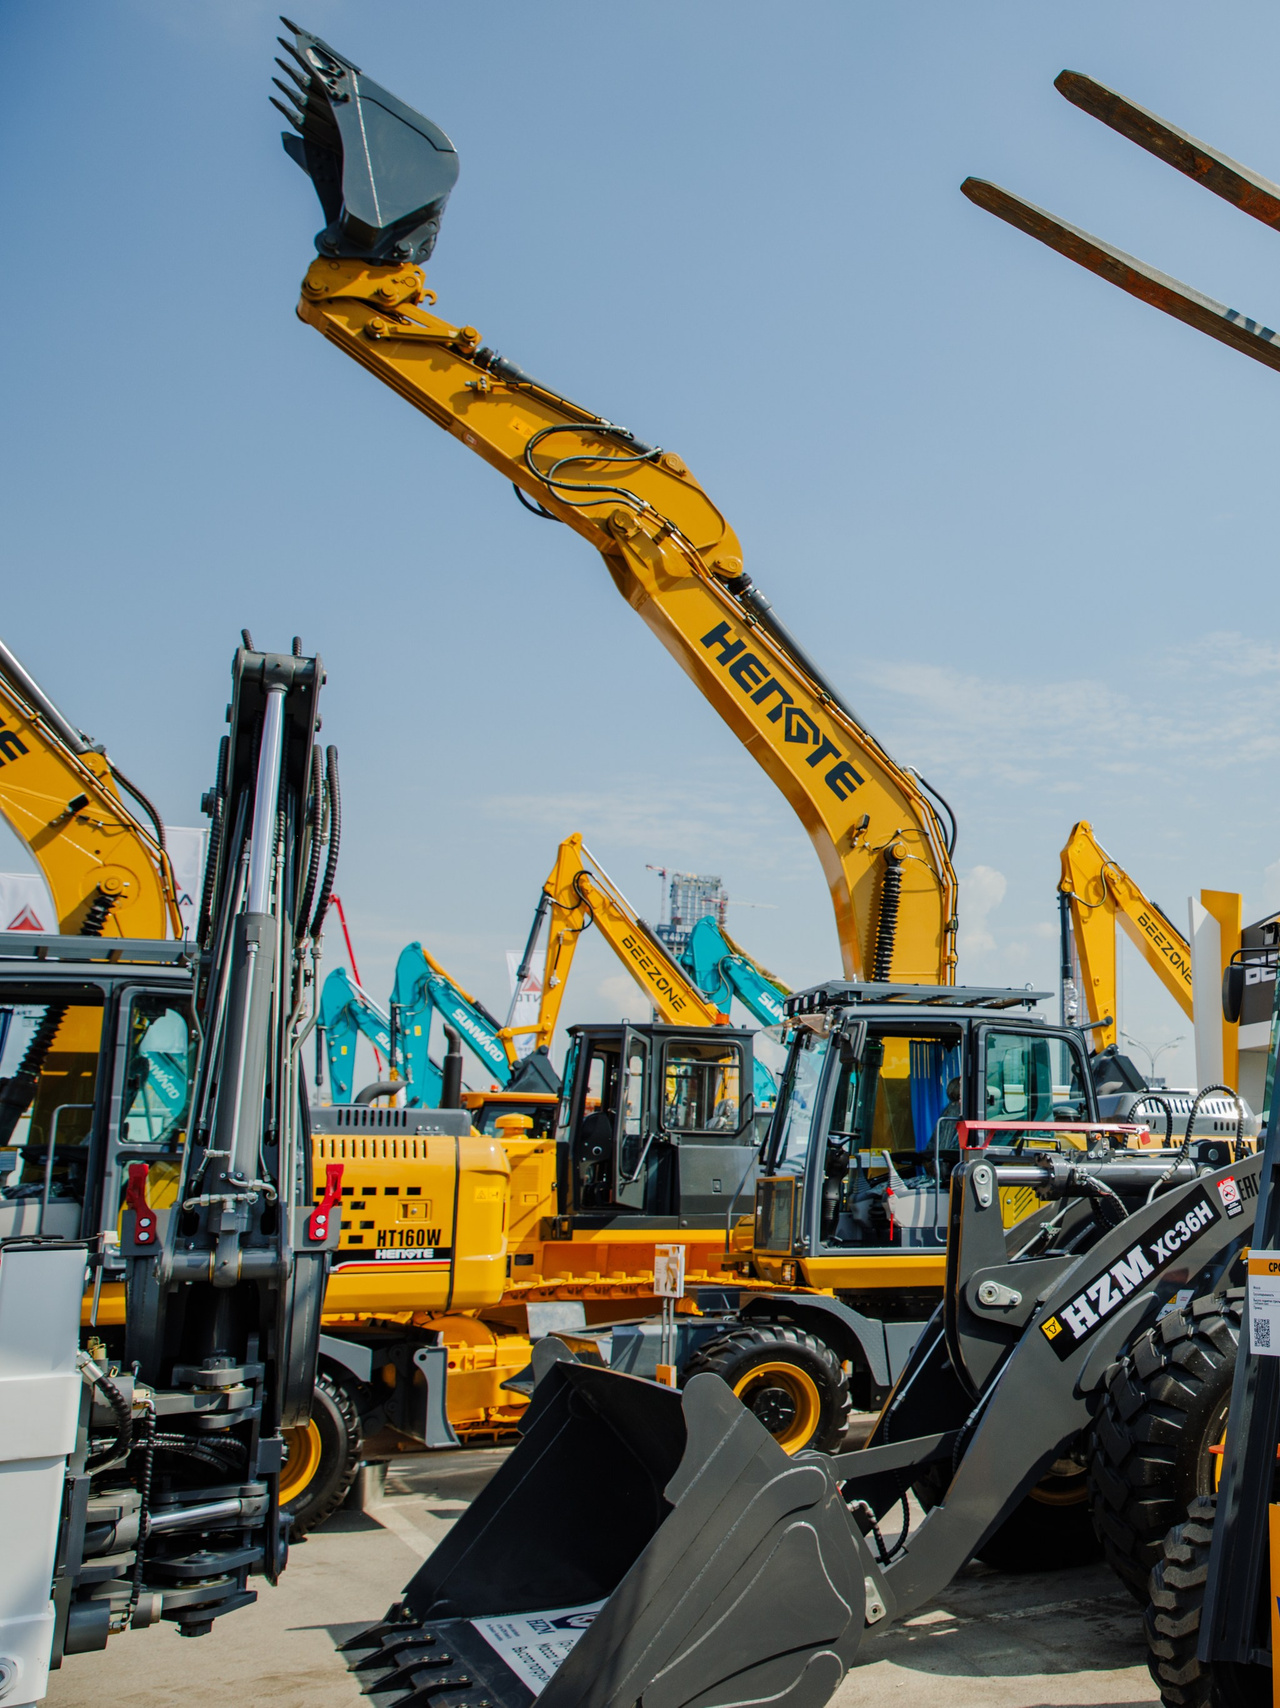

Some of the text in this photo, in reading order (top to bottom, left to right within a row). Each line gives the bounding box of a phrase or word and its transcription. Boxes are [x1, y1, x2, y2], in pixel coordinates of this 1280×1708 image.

[452, 1008, 504, 1062] SUNWARD
[377, 1229, 441, 1247] HT160W
[1060, 1200, 1215, 1340] HZM XC36H
[526, 1619, 555, 1635] HZM
